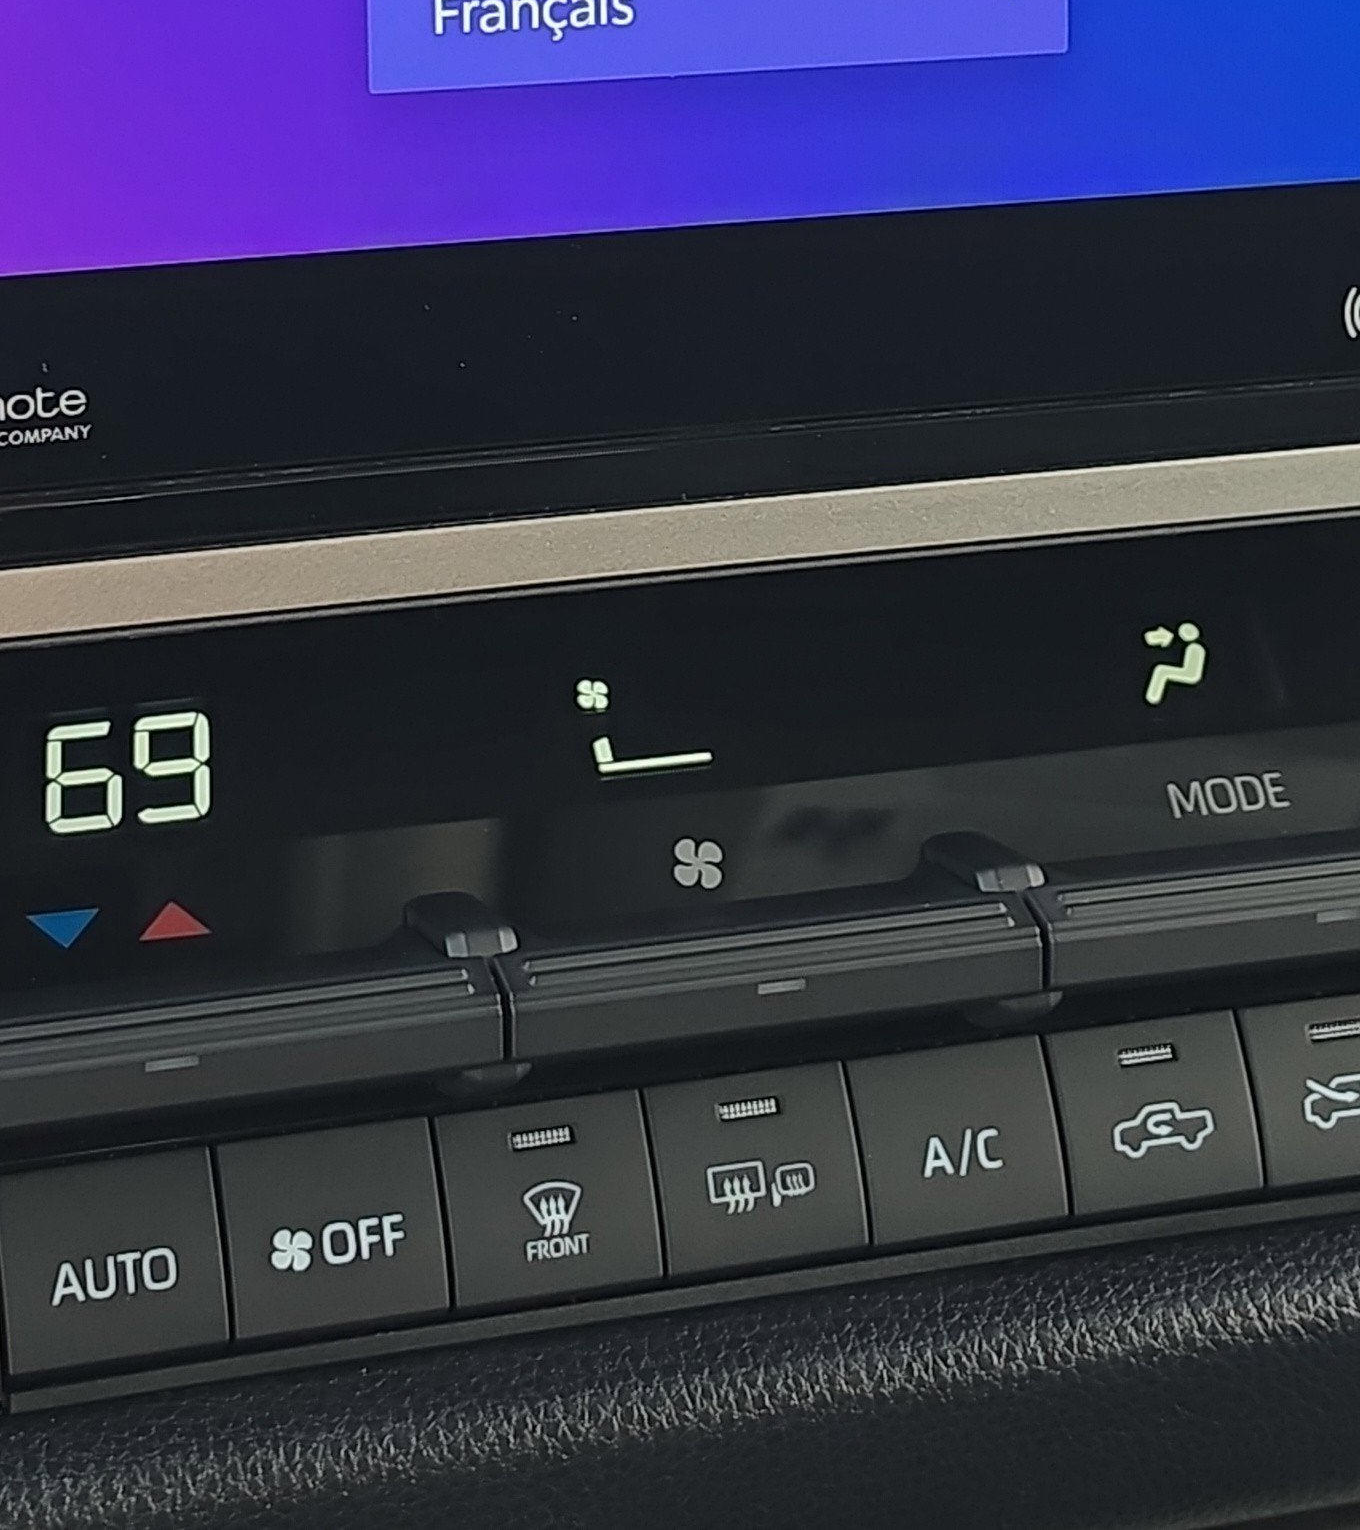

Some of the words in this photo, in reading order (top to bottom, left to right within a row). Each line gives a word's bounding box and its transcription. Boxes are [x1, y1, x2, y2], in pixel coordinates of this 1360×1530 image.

[45, 711, 212, 837] 69
[1166, 773, 1292, 819] MODE
[924, 1127, 1004, 1178] A/C
[322, 1213, 406, 1266] OFF
[525, 1233, 591, 1262] FRONT
[51, 1247, 179, 1307] AUTO
